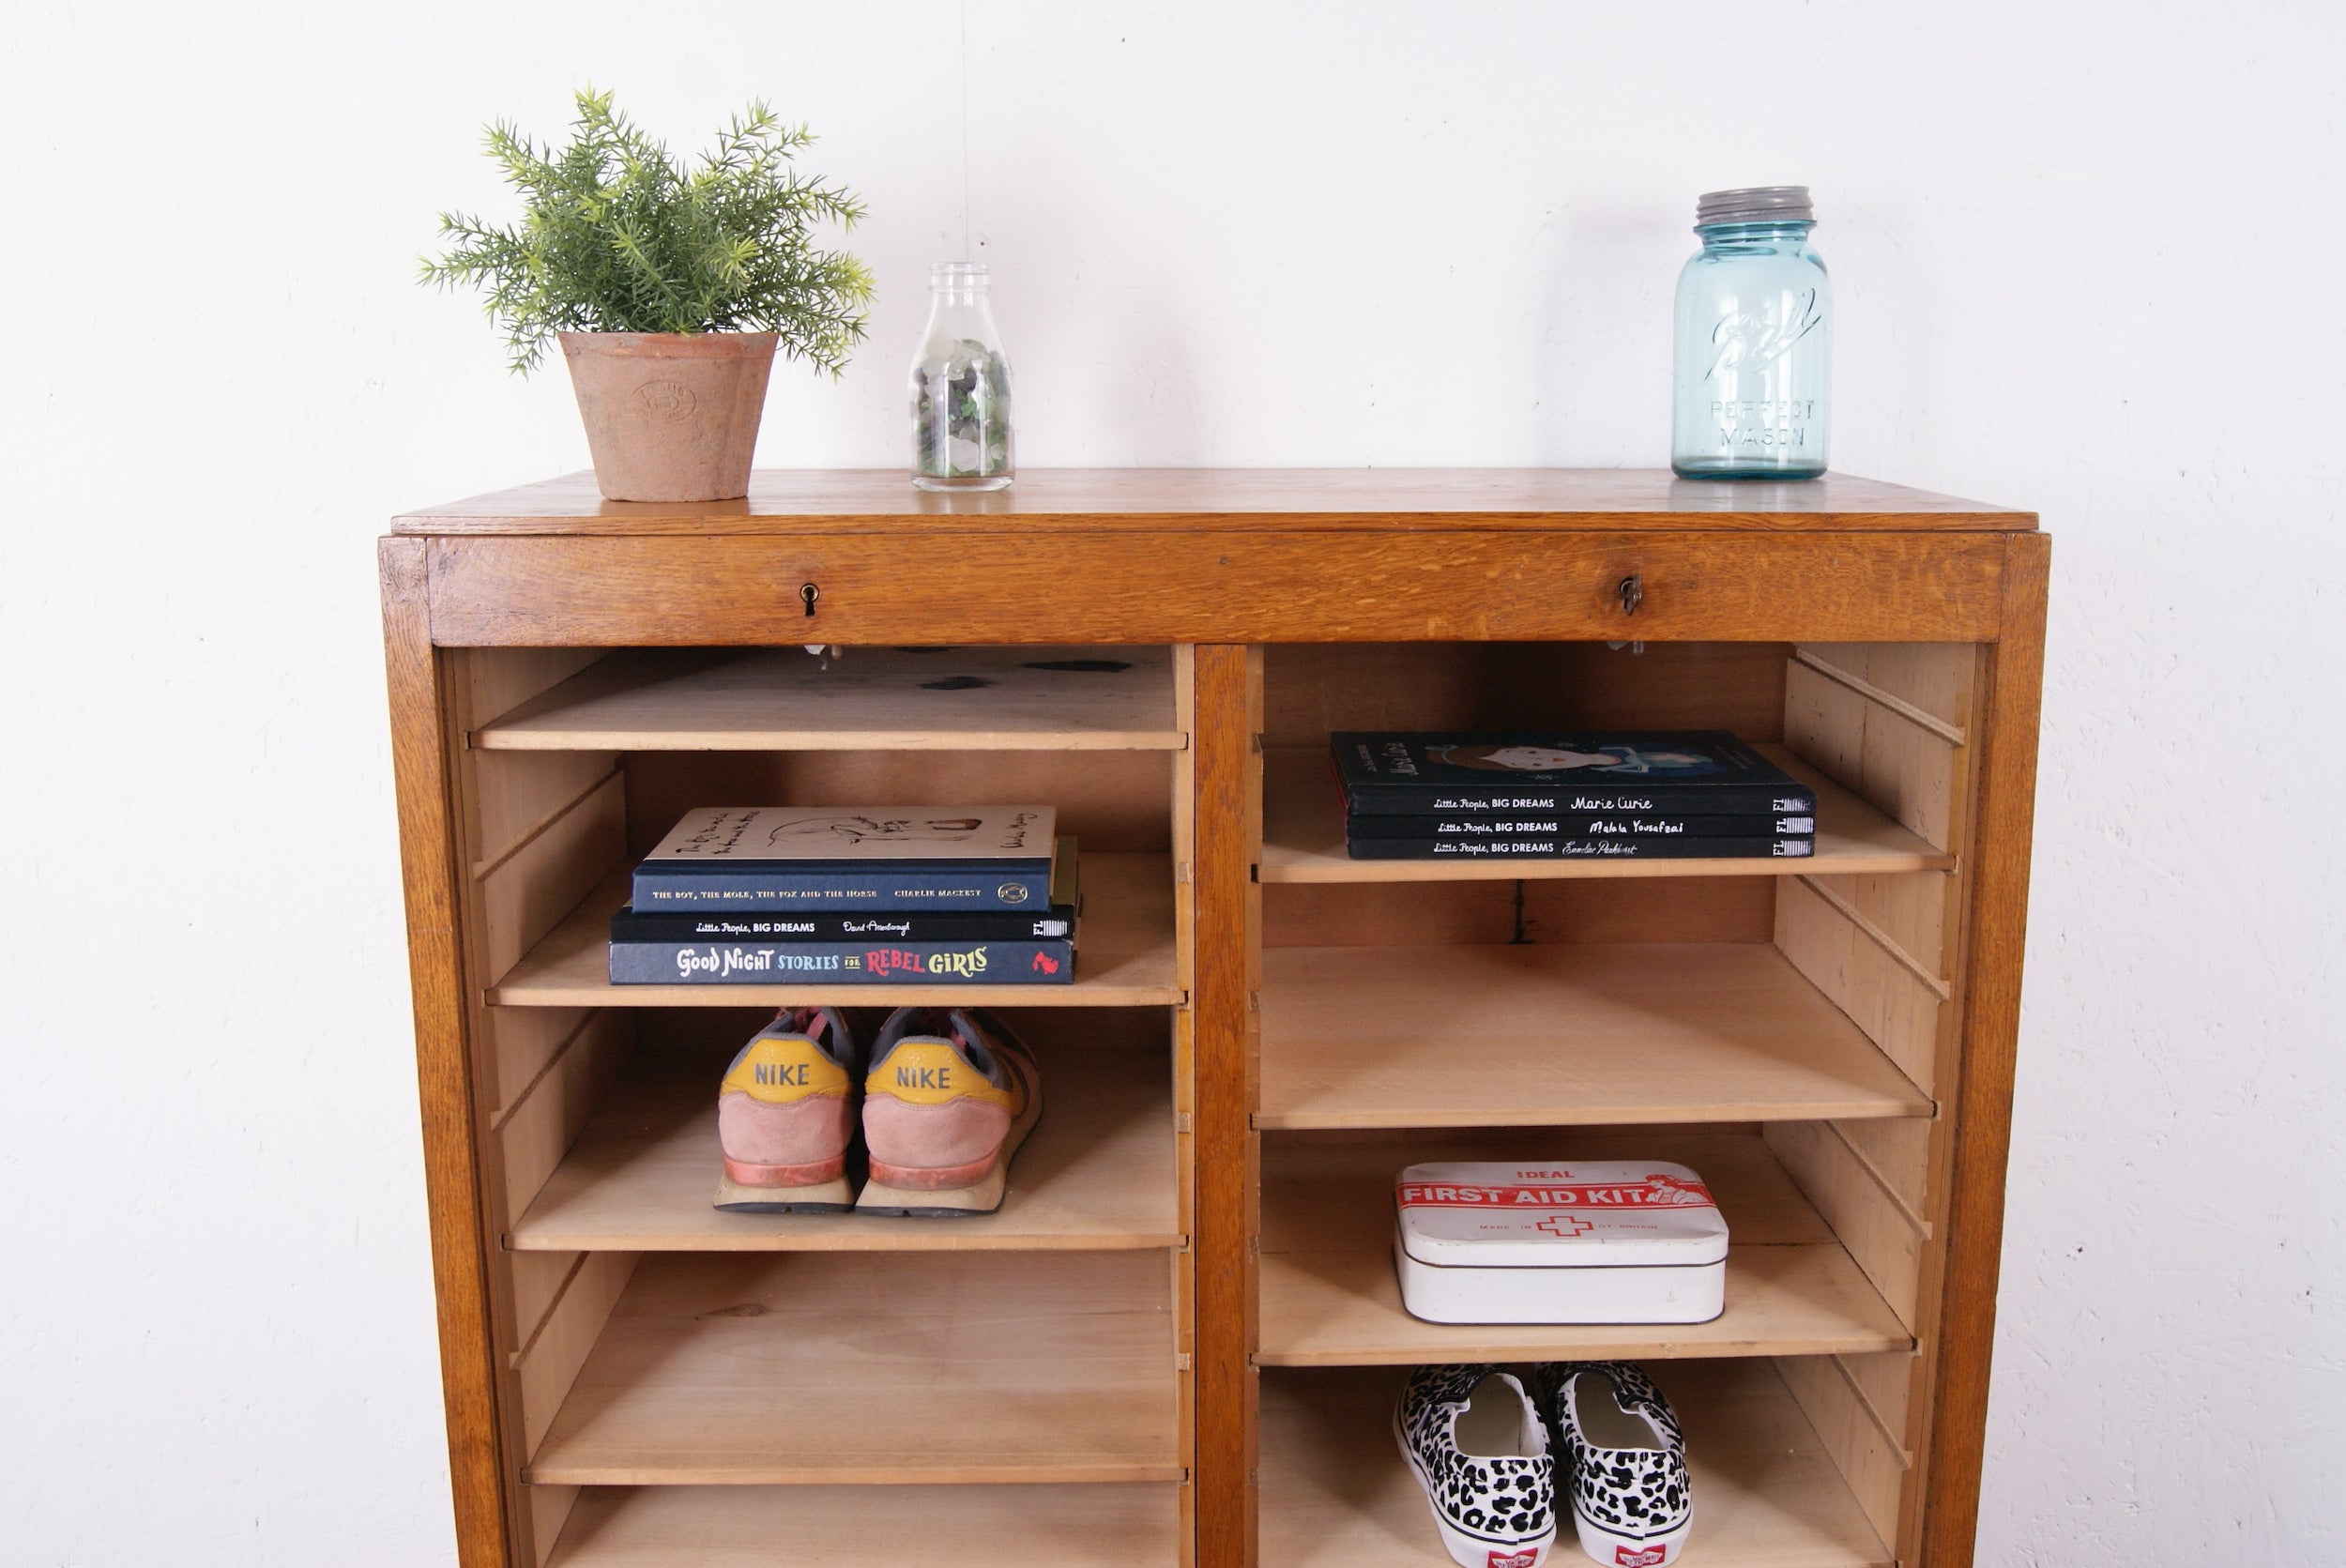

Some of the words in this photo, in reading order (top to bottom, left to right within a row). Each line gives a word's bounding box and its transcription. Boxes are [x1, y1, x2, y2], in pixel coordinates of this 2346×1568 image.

[1710, 401, 1816, 419] PERFECT
[1720, 427, 1806, 447] MASON
[1434, 799, 1458, 808] Little
[1491, 799, 1510, 808] BIG
[1512, 799, 1554, 808] DREAMS
[1570, 797, 1614, 810] Marie
[1617, 797, 1653, 810] Curie
[1438, 823, 1462, 832] Little
[1495, 823, 1513, 832] BIG
[1516, 822, 1558, 832] DREAMS
[1589, 821, 1627, 834] Malala
[1633, 820, 1683, 834] Yousafzai
[1433, 843, 1458, 853] Little
[1491, 844, 1510, 853] BIG
[1512, 844, 1554, 853] DREAMS
[675, 891, 698, 901] BOY,
[723, 891, 753, 901] MOLE,
[695, 922, 720, 933] Little
[753, 923, 771, 933] BIG
[773, 923, 815, 933] DREAMS
[843, 921, 865, 932] David
[778, 954, 840, 971] STORIES
[865, 949, 926, 977] REBEL
[754, 1063, 811, 1087] NIKE
[896, 1066, 951, 1089] NIKE
[1516, 1170, 1576, 1180] IDEAL
[1404, 1187, 1503, 1203] FIRST
[1516, 1189, 1578, 1204] AID
[1588, 1188, 1645, 1204] KIT
